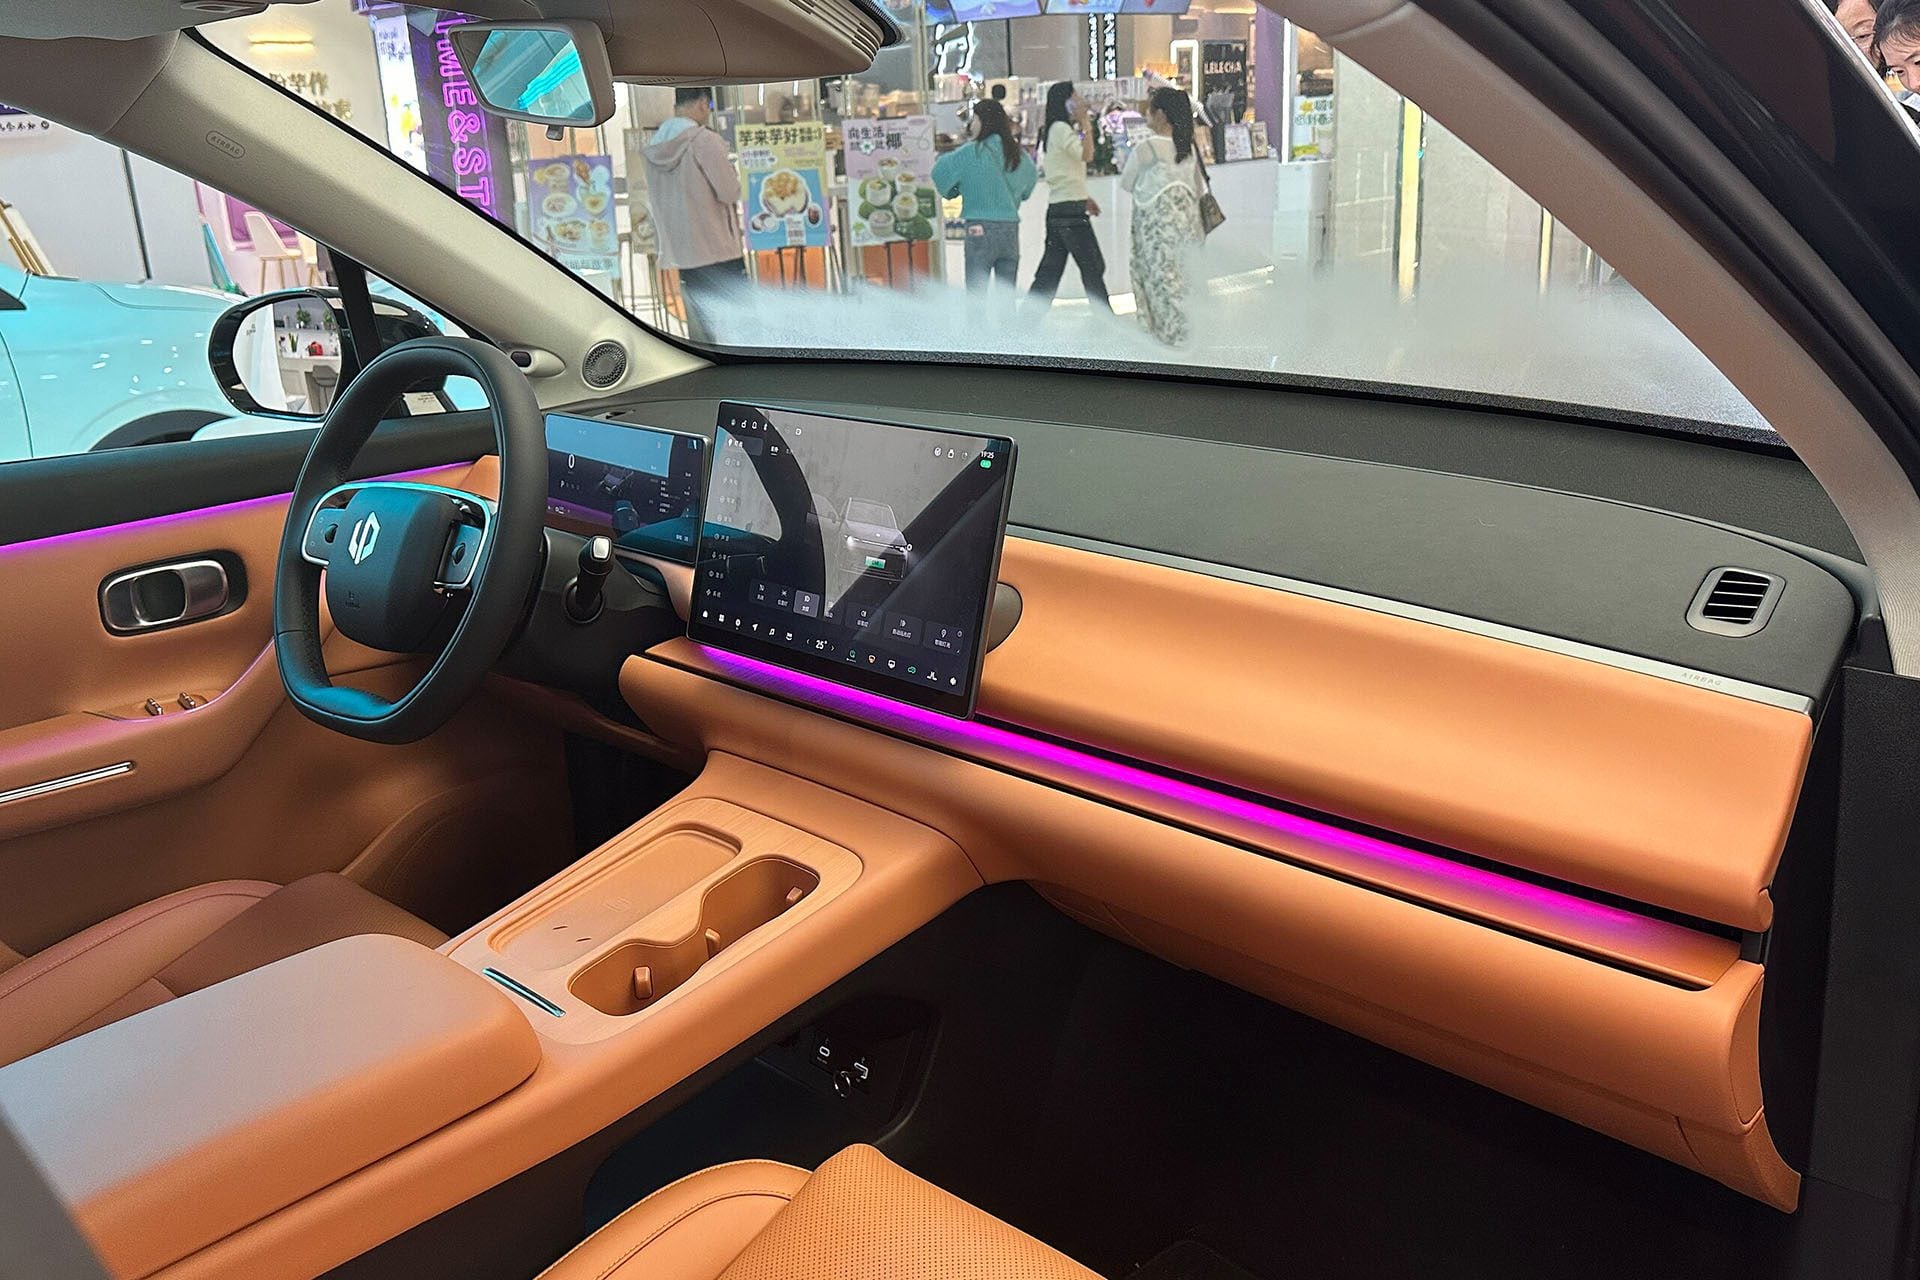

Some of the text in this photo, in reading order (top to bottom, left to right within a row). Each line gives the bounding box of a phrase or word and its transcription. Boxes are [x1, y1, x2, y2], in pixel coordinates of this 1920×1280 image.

[211, 135, 240, 155] AIRBAG
[568, 454, 575, 469] 0
[1681, 672, 1722, 686] AIRBAG
